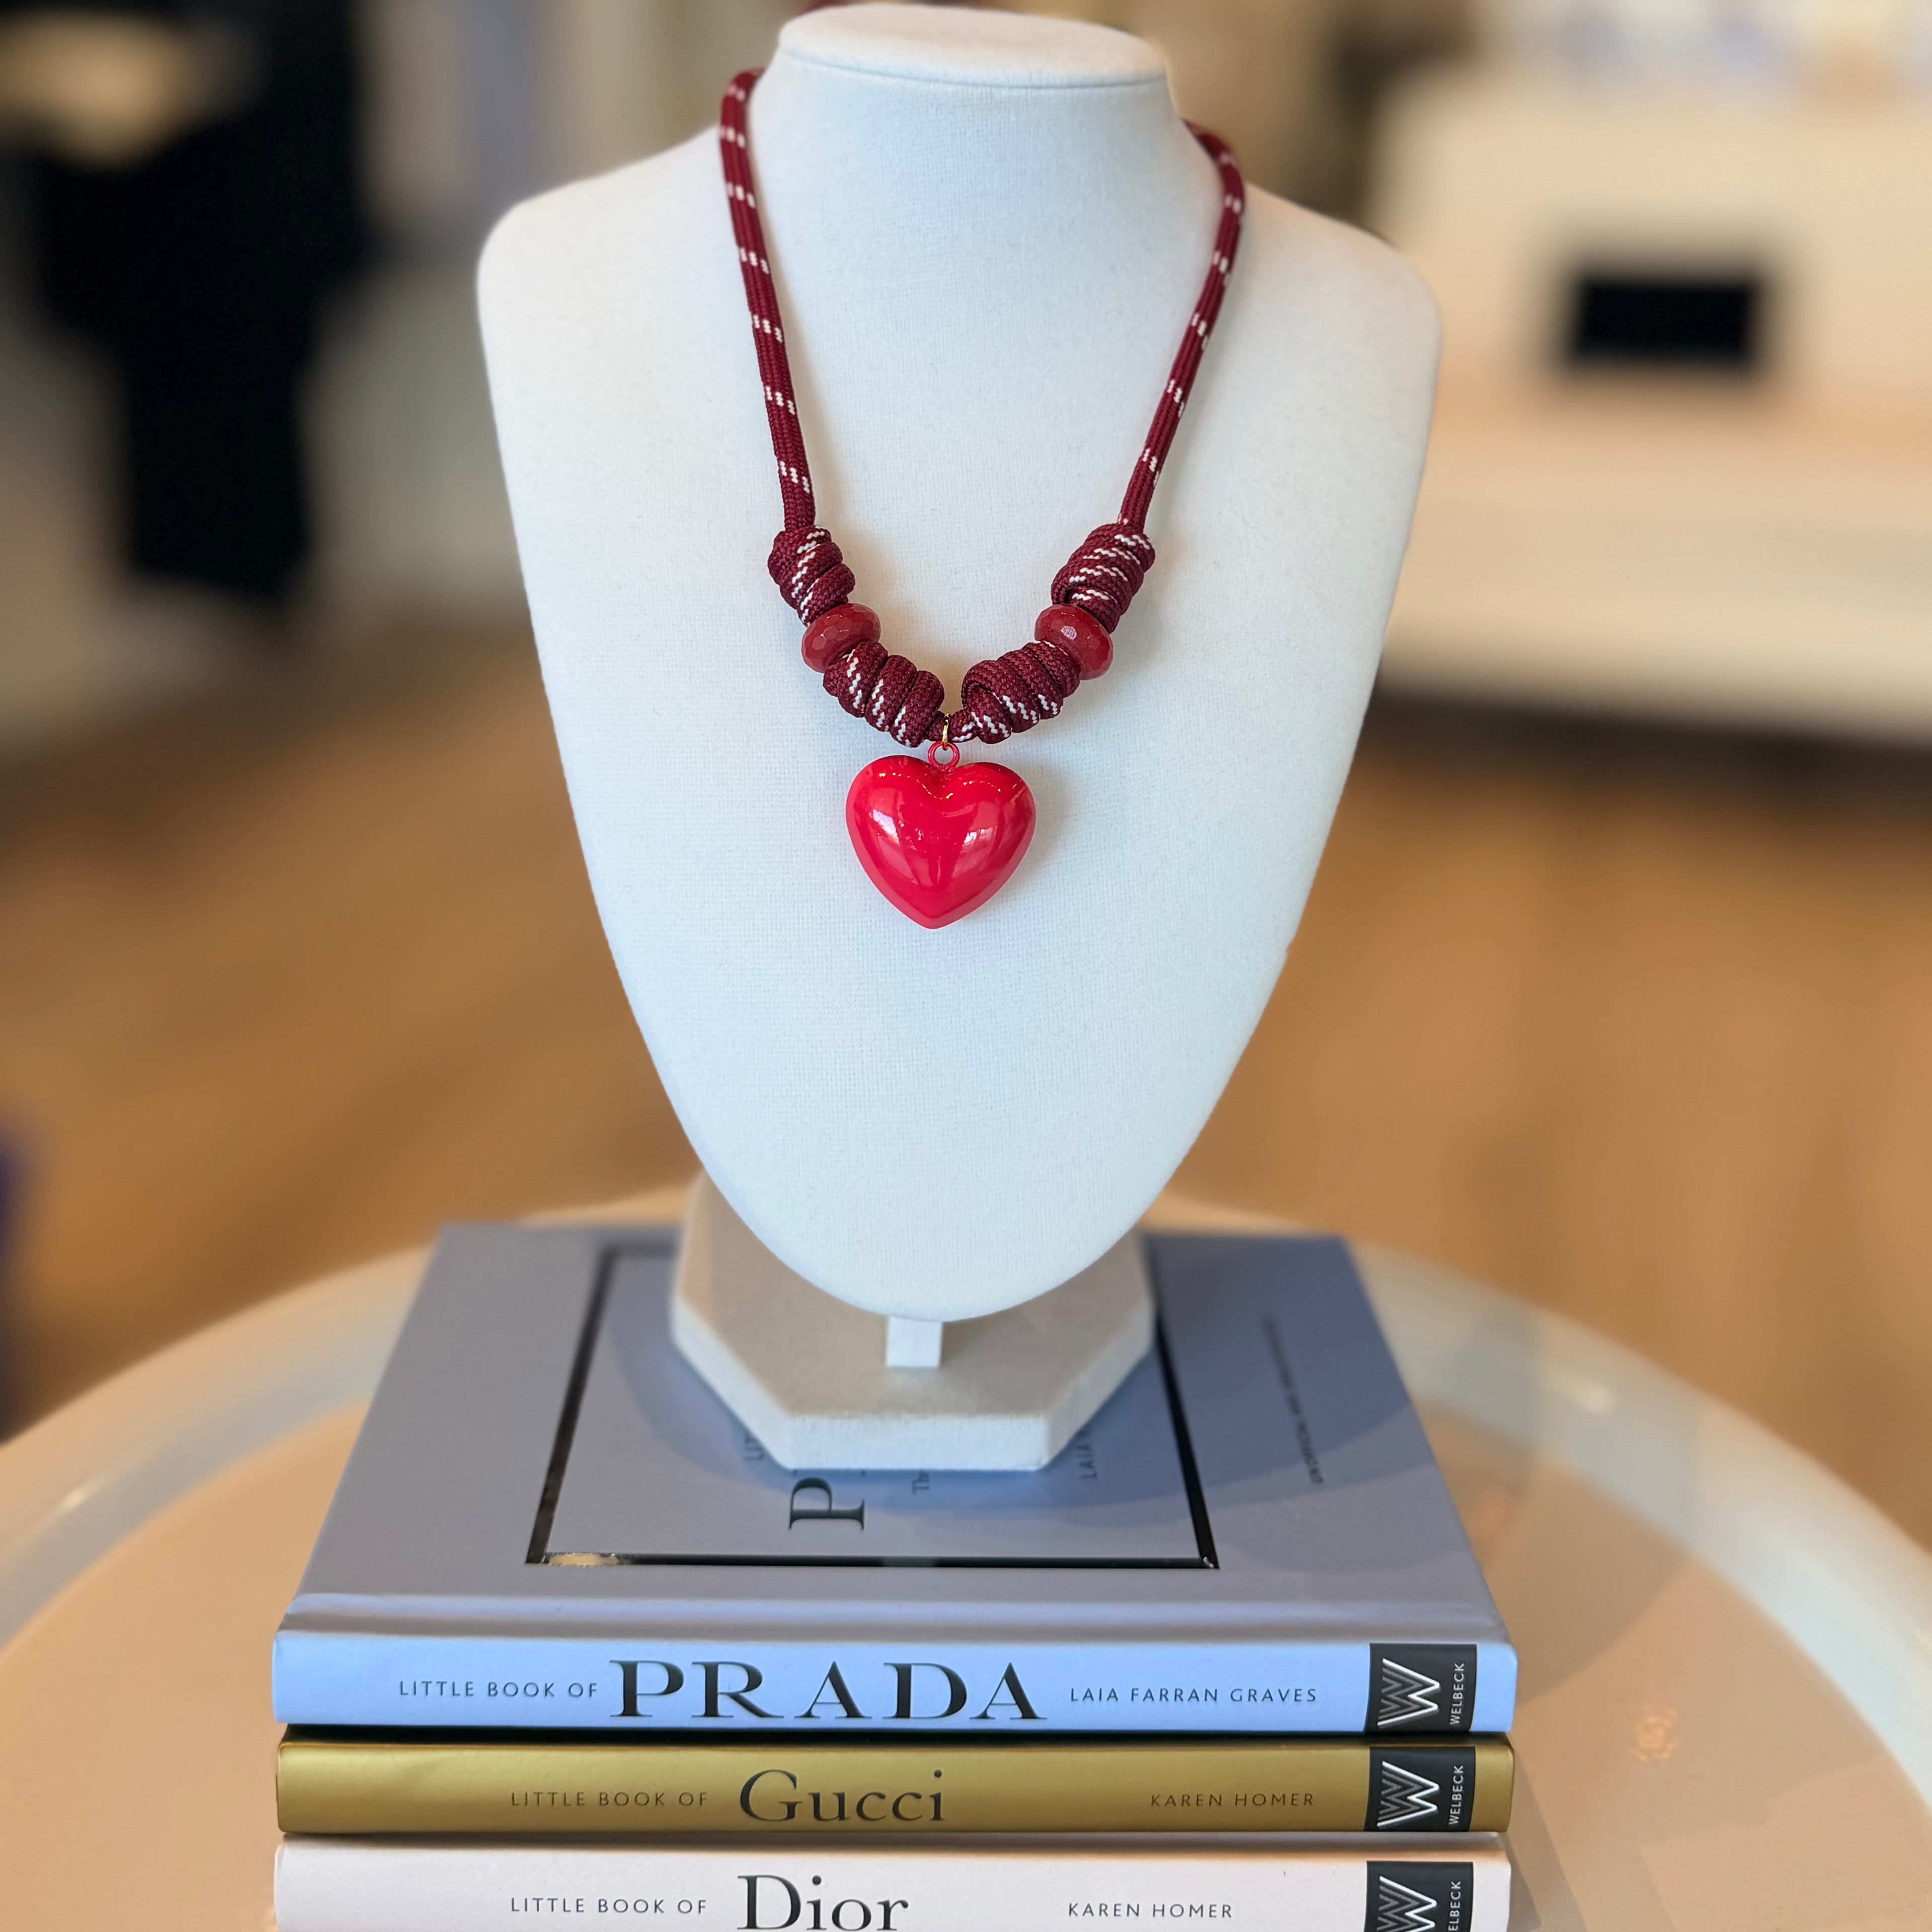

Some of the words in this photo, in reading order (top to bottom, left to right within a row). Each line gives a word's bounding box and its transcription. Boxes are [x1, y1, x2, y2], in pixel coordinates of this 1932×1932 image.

[788, 1469, 865, 1530] P
[400, 1681, 474, 1697] LITTLE
[488, 1682, 555, 1698] BOOK
[568, 1682, 597, 1698] OF
[609, 1660, 1048, 1720] PRADA
[1071, 1687, 1119, 1702] LAIA
[1131, 1687, 1218, 1702] FARRAN
[1230, 1688, 1316, 1702] GRAVES
[1450, 1663, 1465, 1725] WELBECK
[511, 1792, 585, 1807] LITTLE
[598, 1792, 666, 1808] BOOK
[678, 1792, 707, 1808] OF
[740, 1769, 945, 1822] Gucci
[1151, 1794, 1223, 1807] KAREN
[1235, 1793, 1314, 1807] HOMER
[1448, 1765, 1464, 1826] WELBECK
[511, 1897, 585, 1913] LITTLE
[598, 1898, 665, 1914] BOOK
[677, 1899, 706, 1914] OF
[737, 1875, 909, 1931] Dior
[1069, 1903, 1140, 1917] KAREN
[1153, 1903, 1232, 1918] HOMER
[1448, 1881, 1461, 1932] ELBECK
